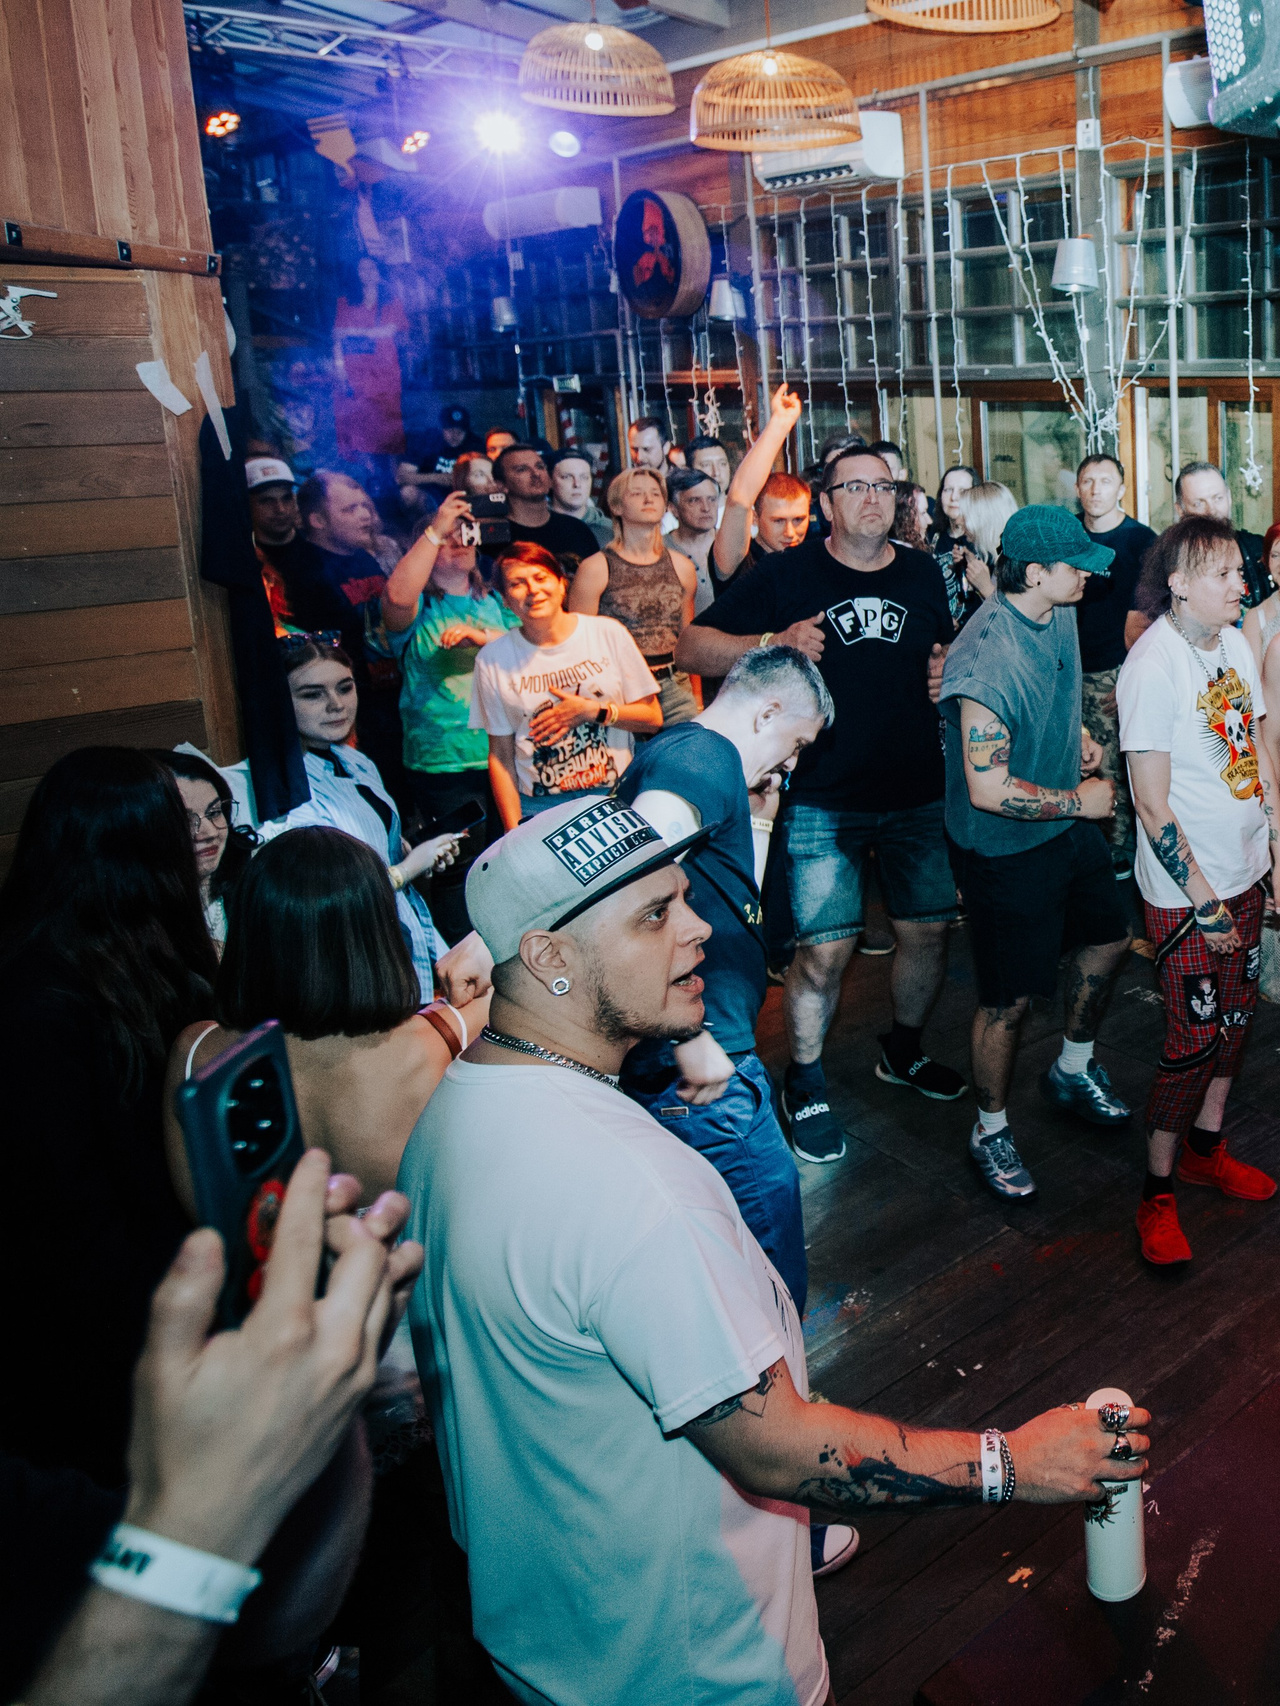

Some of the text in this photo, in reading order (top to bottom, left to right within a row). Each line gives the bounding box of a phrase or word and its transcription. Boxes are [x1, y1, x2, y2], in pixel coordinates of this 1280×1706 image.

[837, 608, 900, 635] FPG
[519, 659, 603, 694] МОЛОДОСТЬ
[579, 839, 630, 879] EXPLICIT
[795, 1102, 830, 1121] adidas
